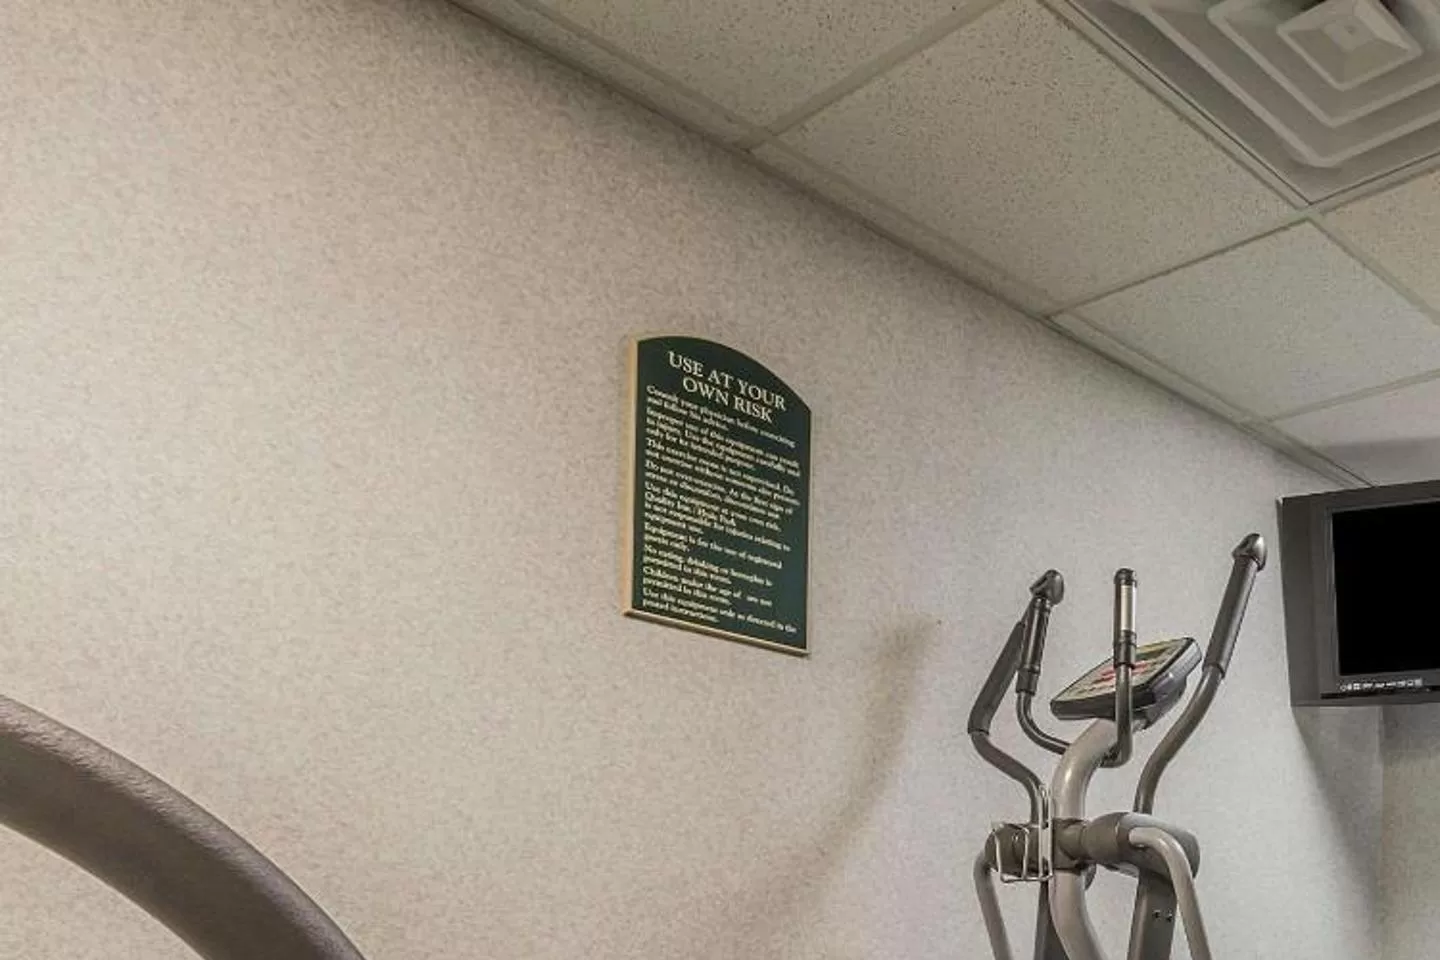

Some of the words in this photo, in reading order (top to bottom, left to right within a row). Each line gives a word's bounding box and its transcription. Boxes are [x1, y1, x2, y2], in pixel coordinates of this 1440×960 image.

[667, 352, 704, 377] USE
[708, 370, 735, 388] AT
[737, 378, 786, 411] YOUR
[683, 377, 729, 406] OWN
[733, 396, 773, 423] RISK
